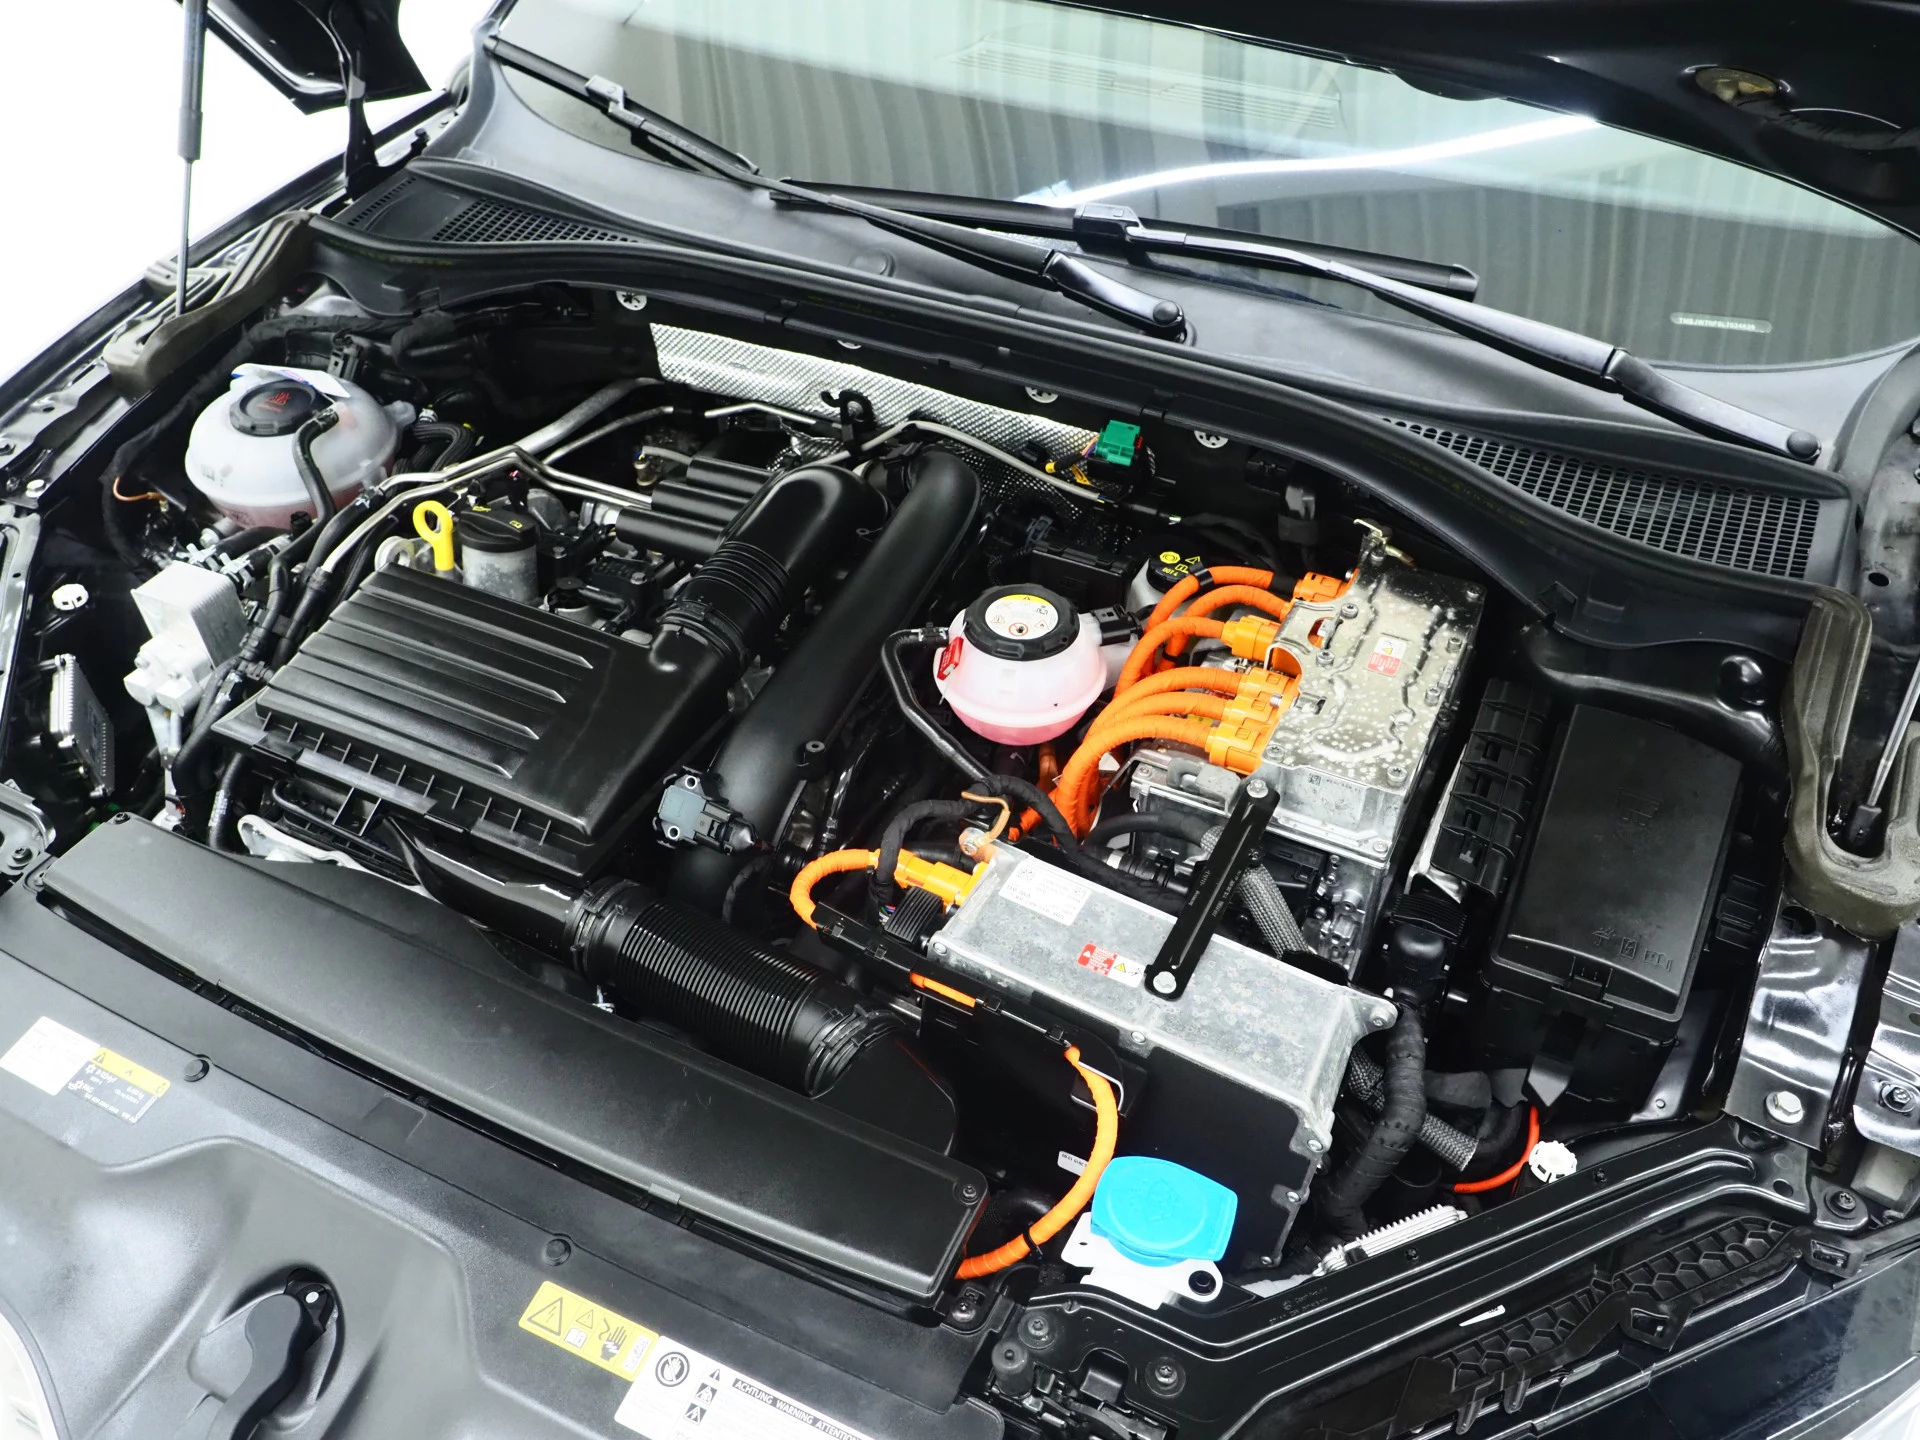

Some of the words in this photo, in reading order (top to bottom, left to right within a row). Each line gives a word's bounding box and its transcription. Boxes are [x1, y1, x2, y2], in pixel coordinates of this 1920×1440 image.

[734, 1380, 774, 1405] ACHTUNG
[775, 1399, 815, 1424] WARNING
[815, 1420, 859, 1440] ATTENTIO
